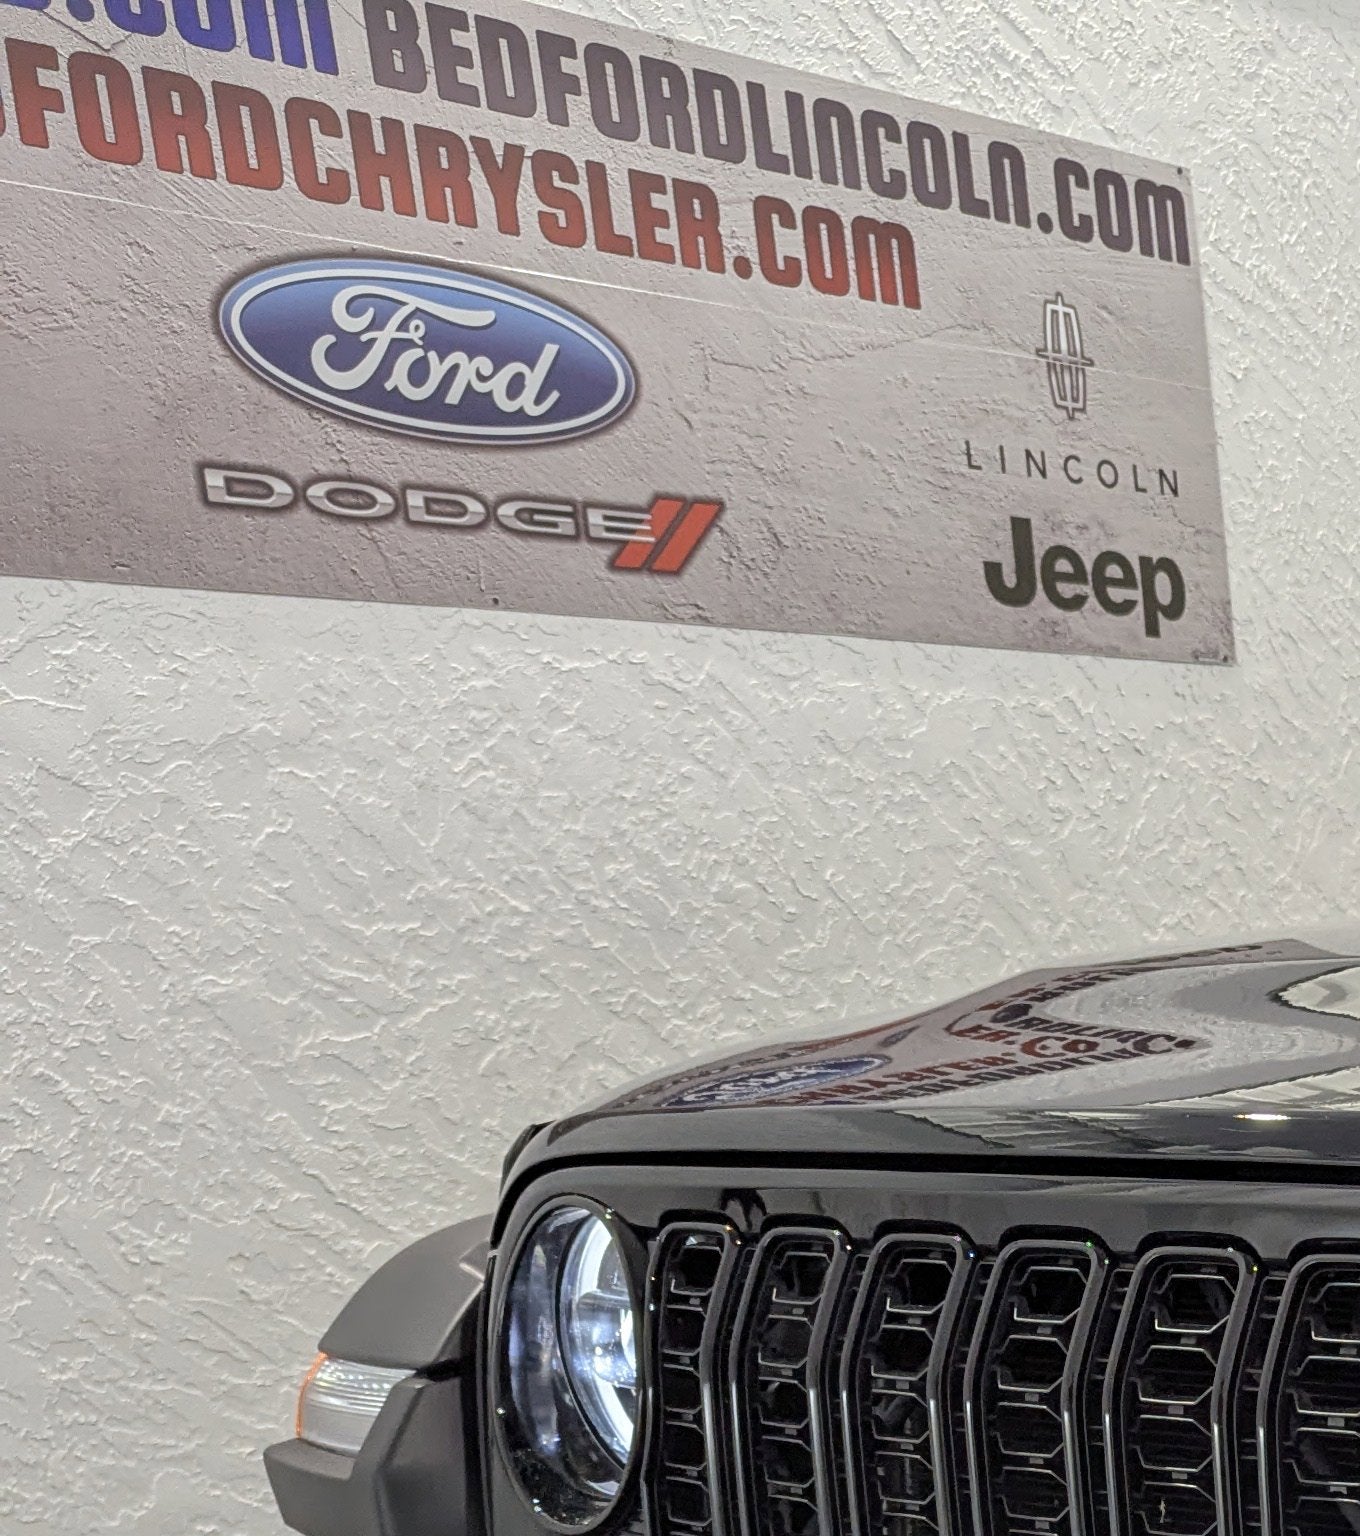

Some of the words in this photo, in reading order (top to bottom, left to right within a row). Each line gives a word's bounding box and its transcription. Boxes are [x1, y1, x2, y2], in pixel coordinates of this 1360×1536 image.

[0, 37, 922, 310] FORDCHRYSLER.COM
[309, 284, 560, 418] Ford
[202, 467, 657, 543] DODGE
[964, 438, 1180, 499] LINCOLN
[982, 515, 1187, 640] Jeep
